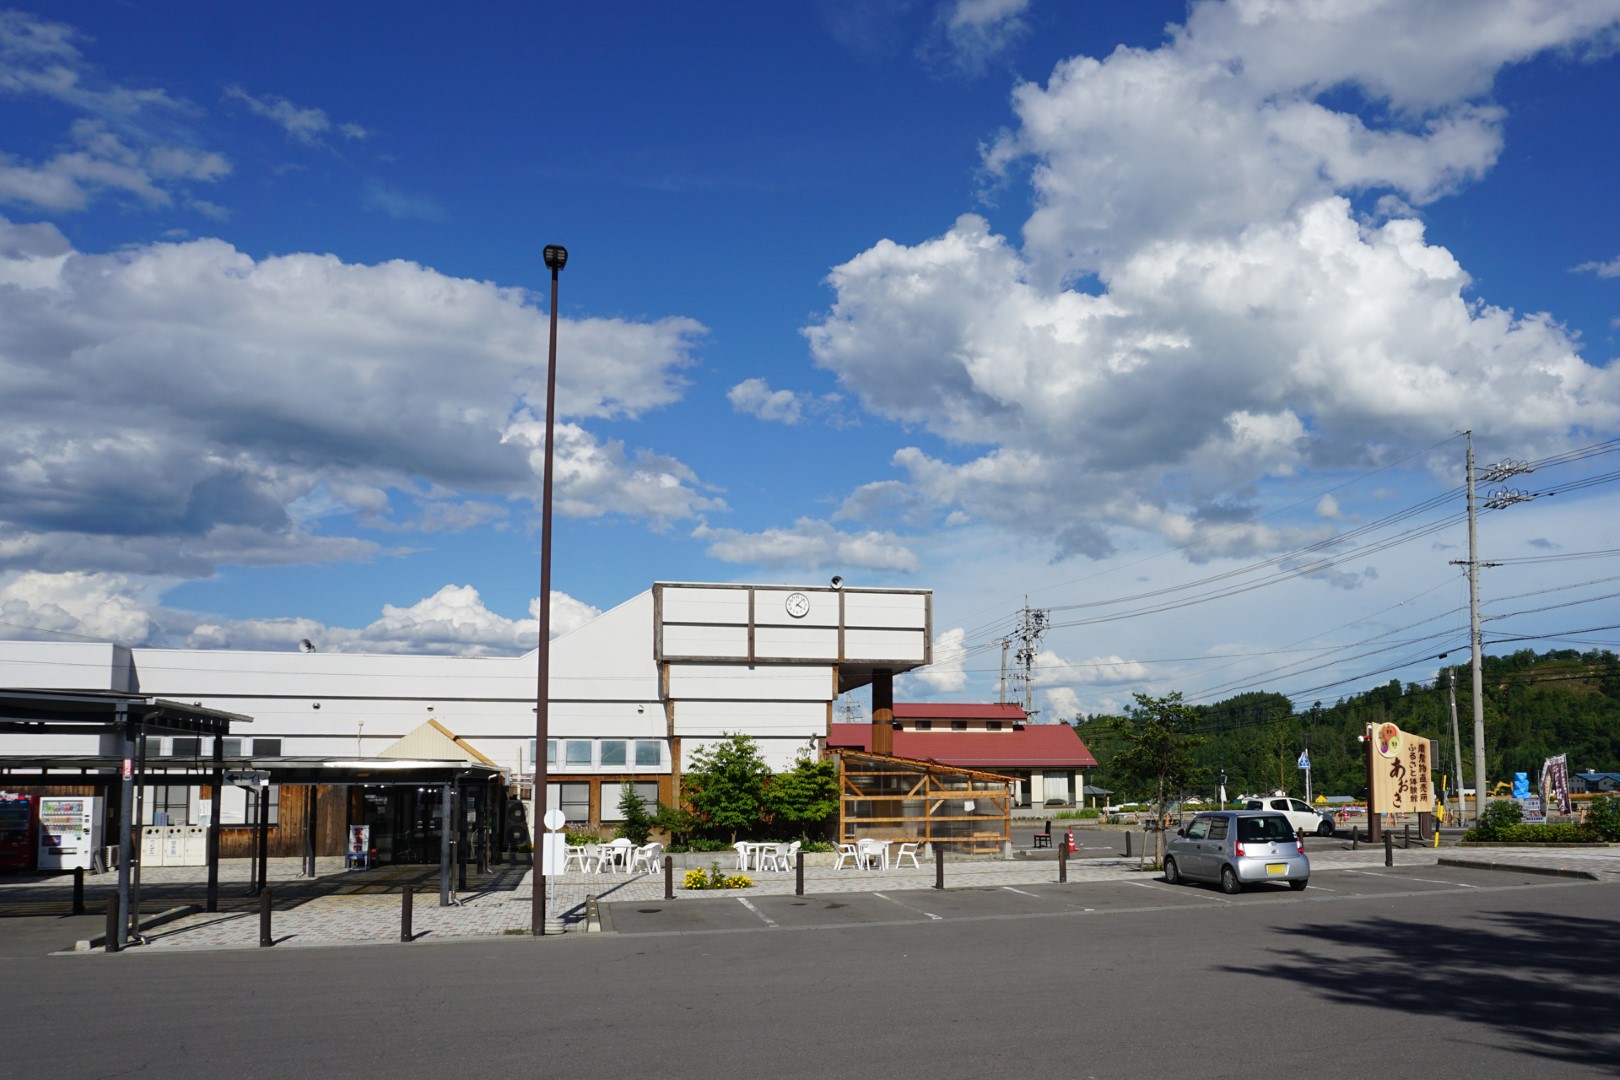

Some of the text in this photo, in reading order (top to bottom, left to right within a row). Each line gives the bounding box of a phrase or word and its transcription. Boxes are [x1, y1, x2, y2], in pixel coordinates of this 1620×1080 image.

[240, 774, 267, 783] トイレ
[1390, 757, 1409, 808] あおき
[1408, 744, 1418, 803] ふるさと体験館
